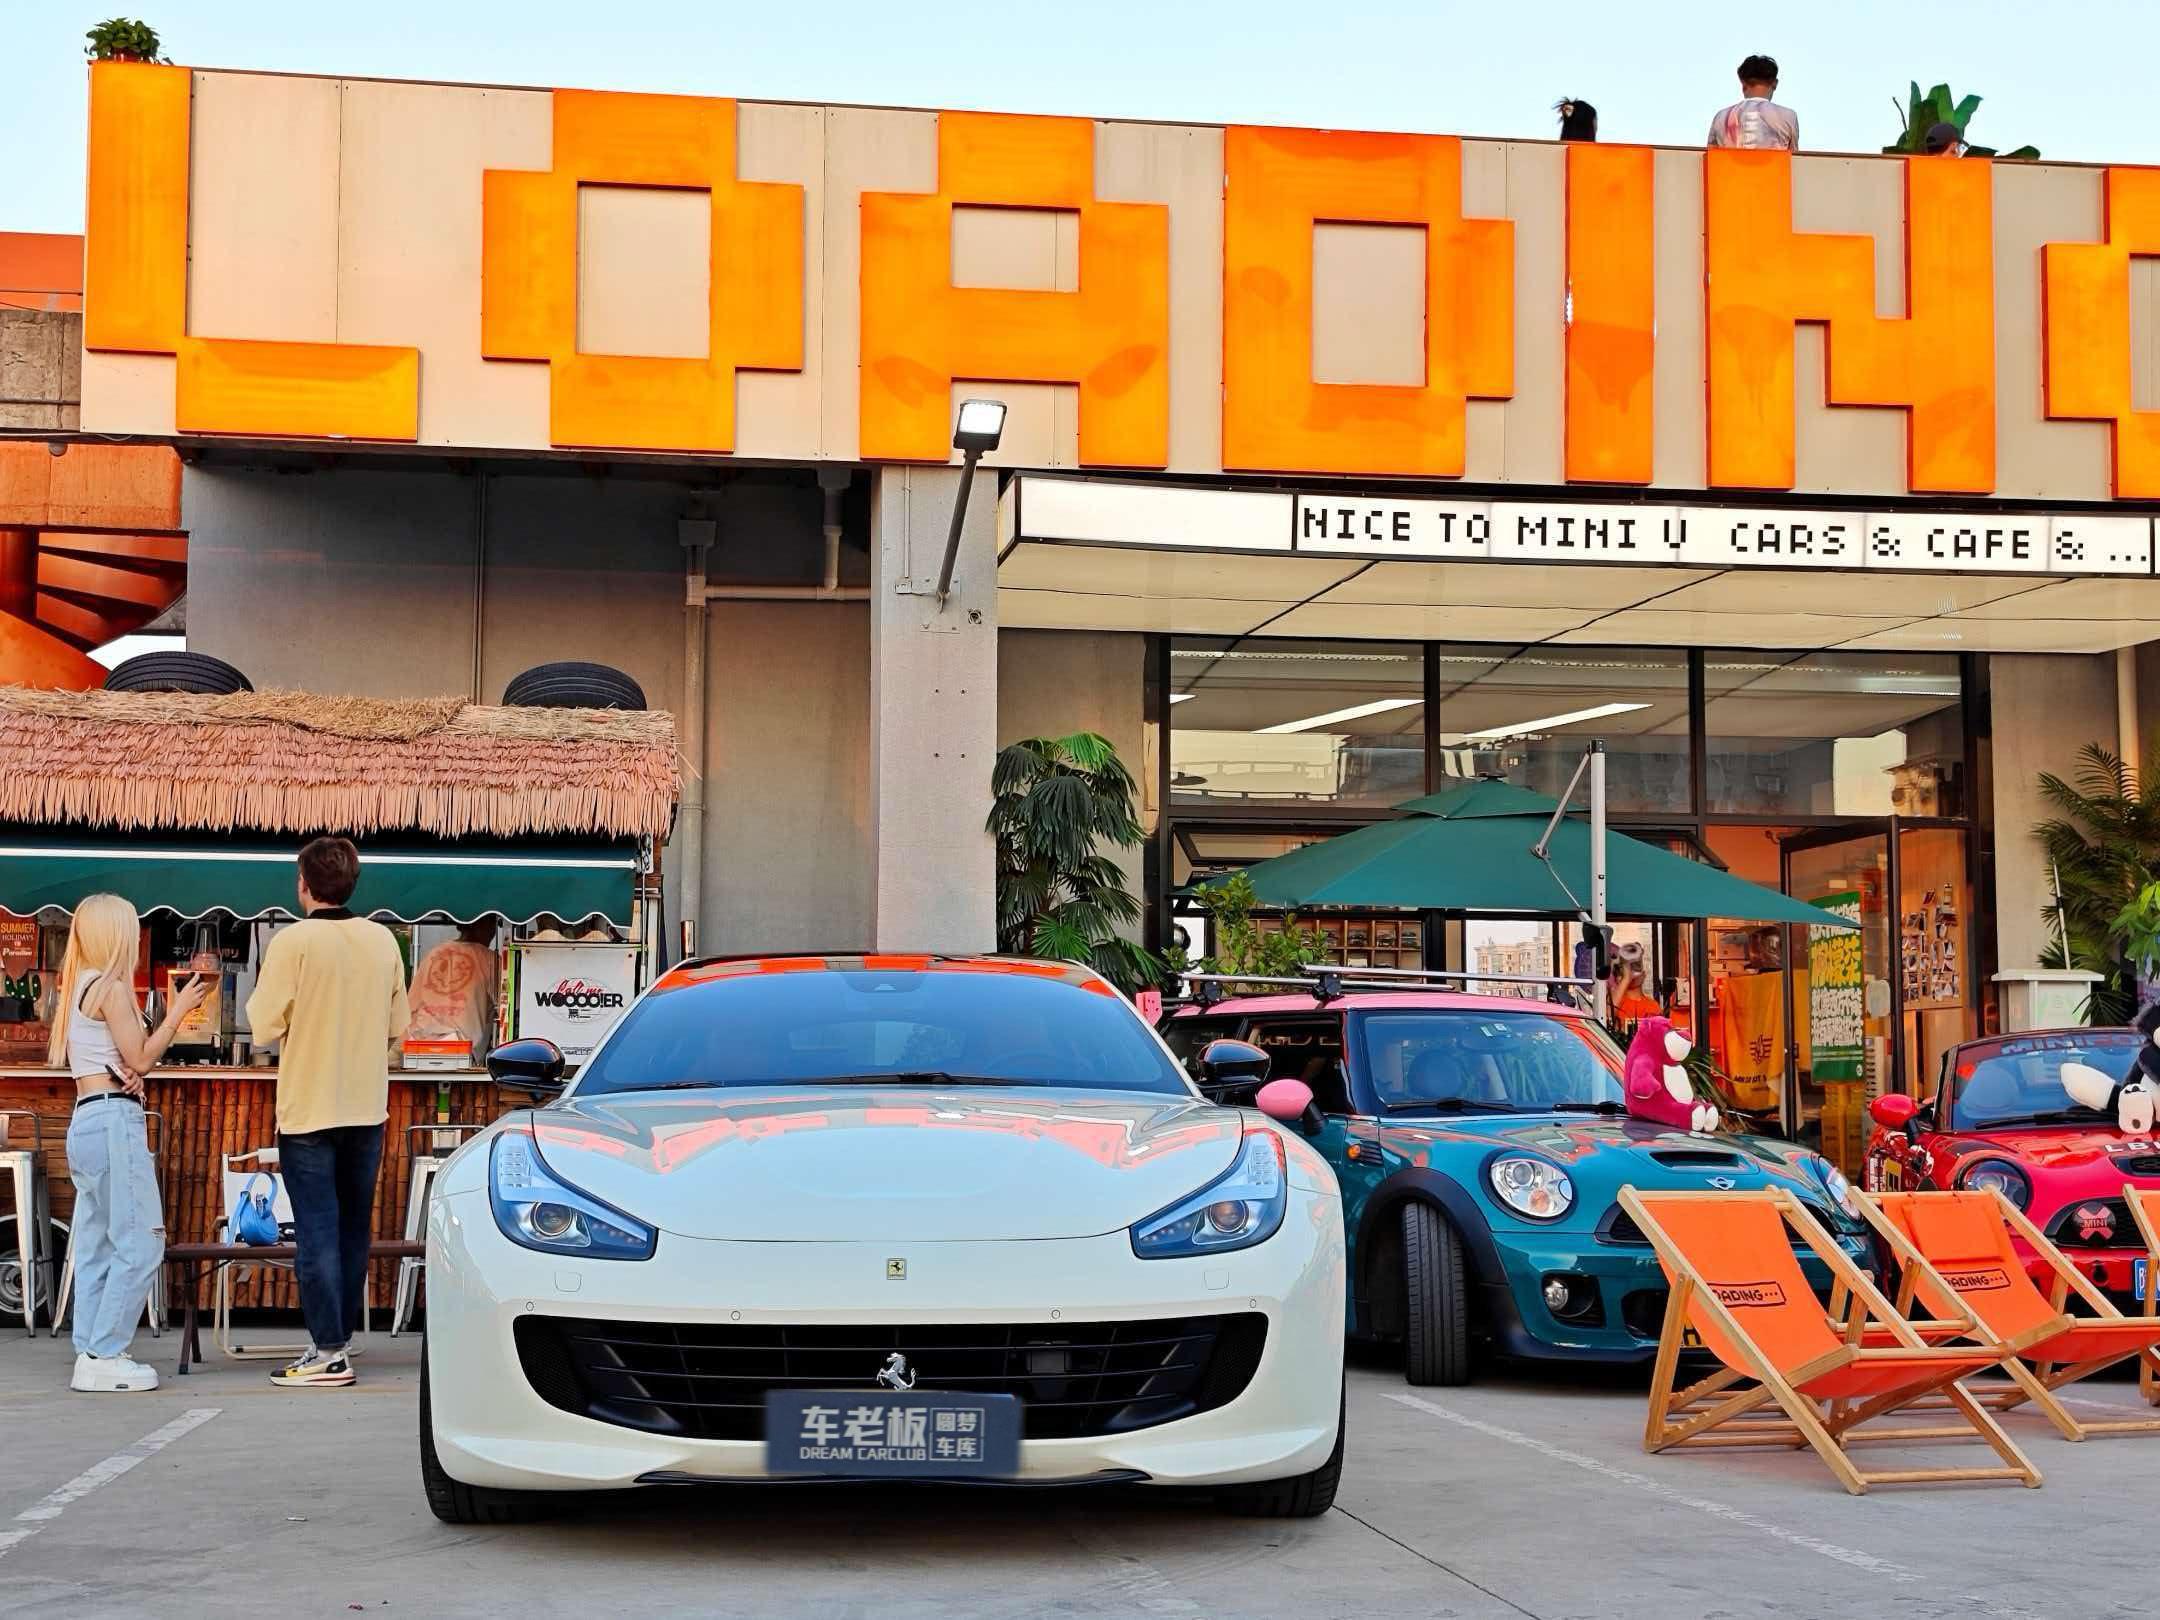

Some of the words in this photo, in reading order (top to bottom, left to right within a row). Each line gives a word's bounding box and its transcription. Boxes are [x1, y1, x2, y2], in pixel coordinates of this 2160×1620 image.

[1303, 507, 1411, 543] NICE
[1438, 512, 1490, 545] TO
[1517, 515, 1637, 549] MINI
[1730, 522, 1846, 555] CARS
[1872, 526, 1901, 557] &
[1927, 528, 2030, 559] CAFE
[2056, 530, 2084, 561] &
[0, 922, 35, 934] SUMMER
